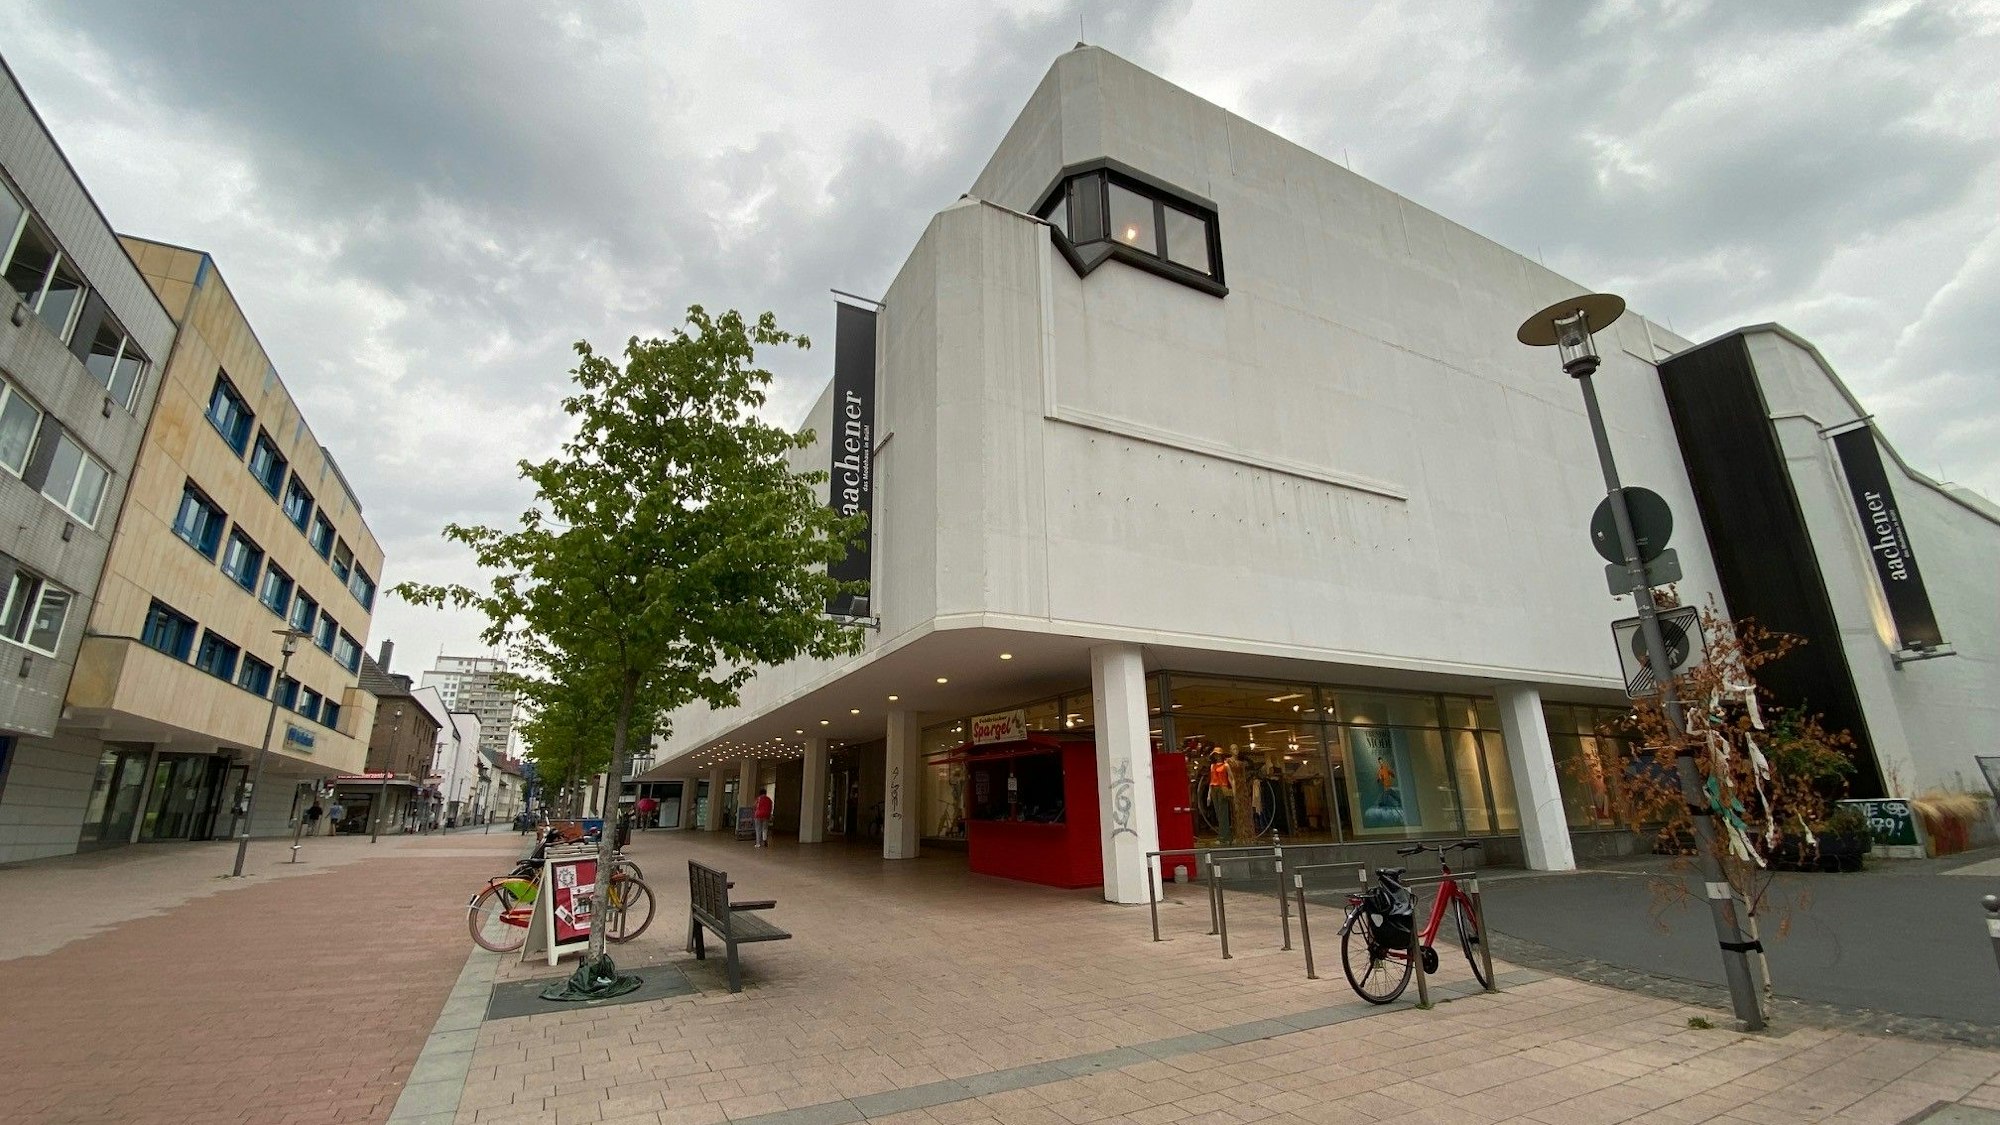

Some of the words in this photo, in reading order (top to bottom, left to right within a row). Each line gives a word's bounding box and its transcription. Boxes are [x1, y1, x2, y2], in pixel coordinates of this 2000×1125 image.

[834, 390, 861, 517] aachener
[1864, 491, 1908, 580] aachener
[974, 716, 1012, 742] Spargel
